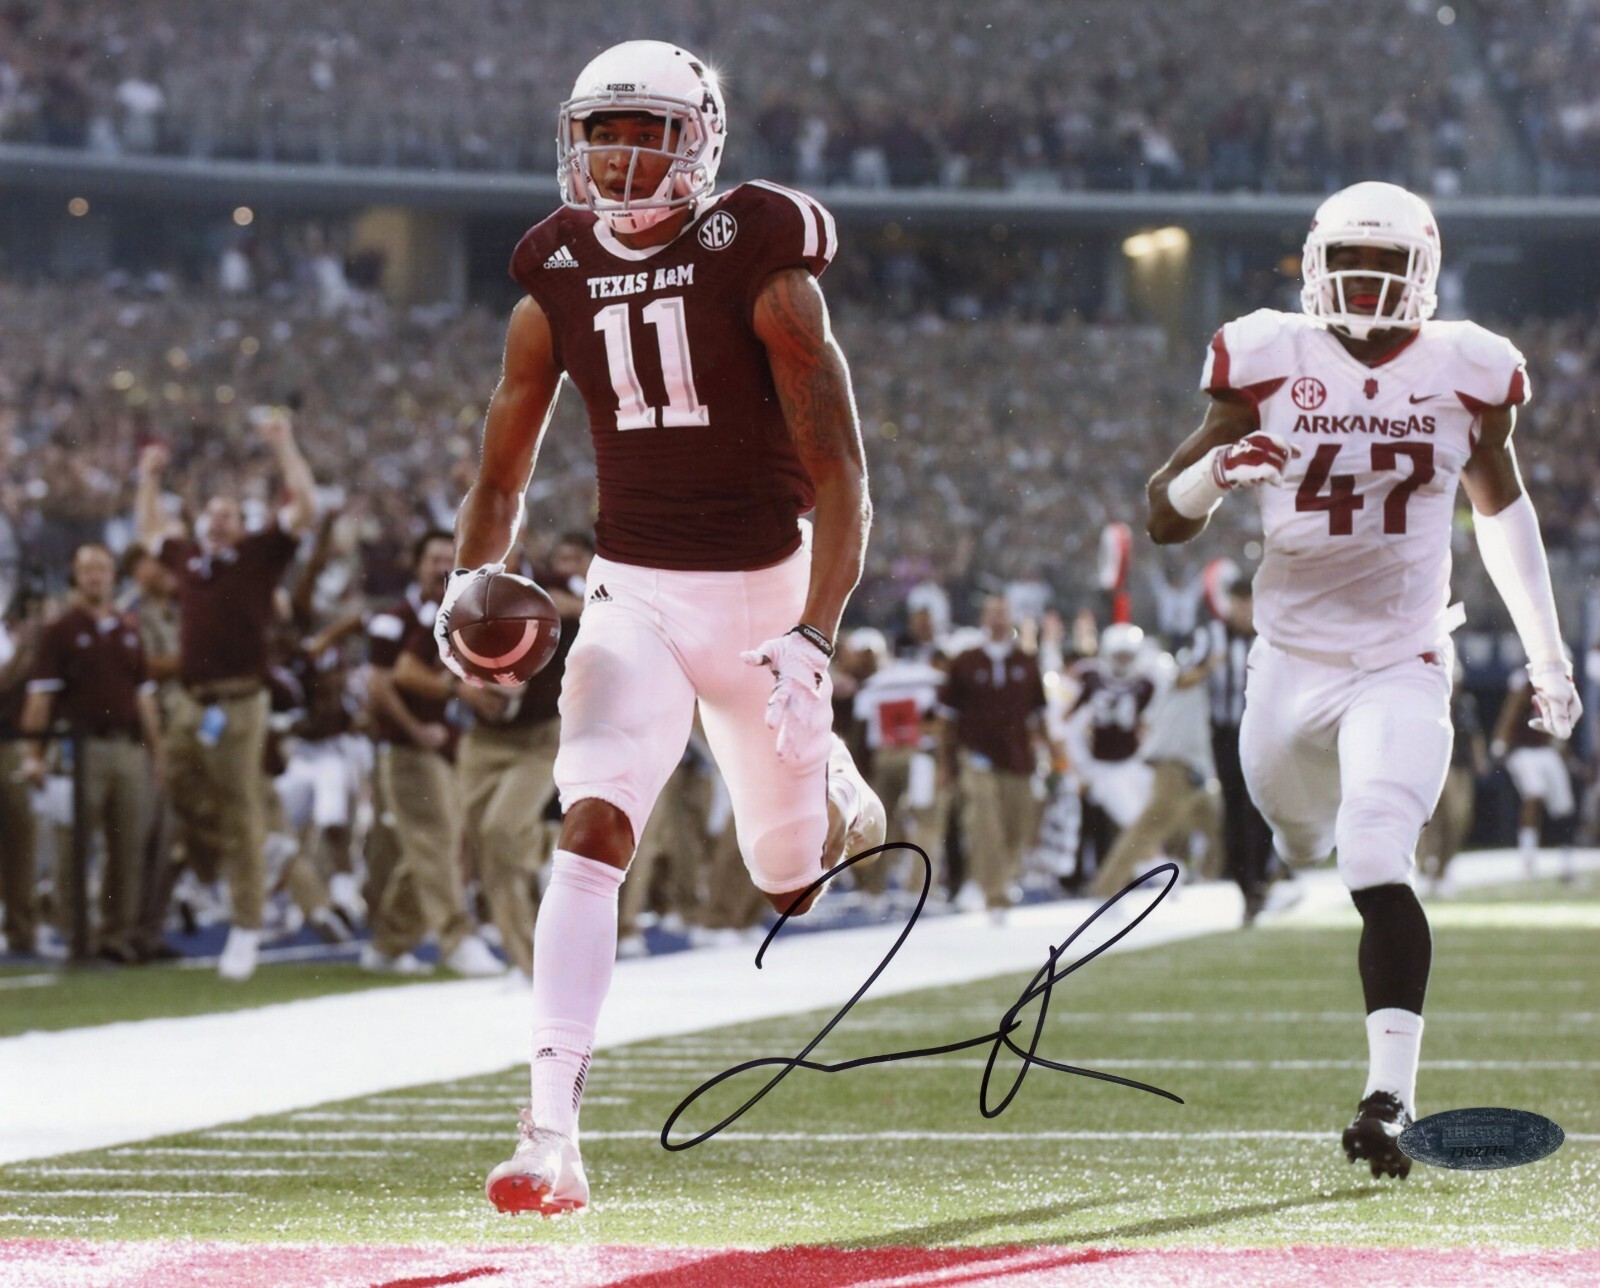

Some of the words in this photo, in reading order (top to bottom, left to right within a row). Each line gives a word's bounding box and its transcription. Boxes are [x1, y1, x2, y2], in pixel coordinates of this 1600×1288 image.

[702, 213, 733, 248] SEC
[543, 260, 579, 270] adidas
[587, 272, 648, 298] TEXAS
[653, 263, 694, 290] A&M
[593, 296, 710, 431] 11
[1292, 377, 1326, 410] SEC
[1293, 414, 1436, 438] ARKANSAS
[1295, 441, 1436, 536] 47
